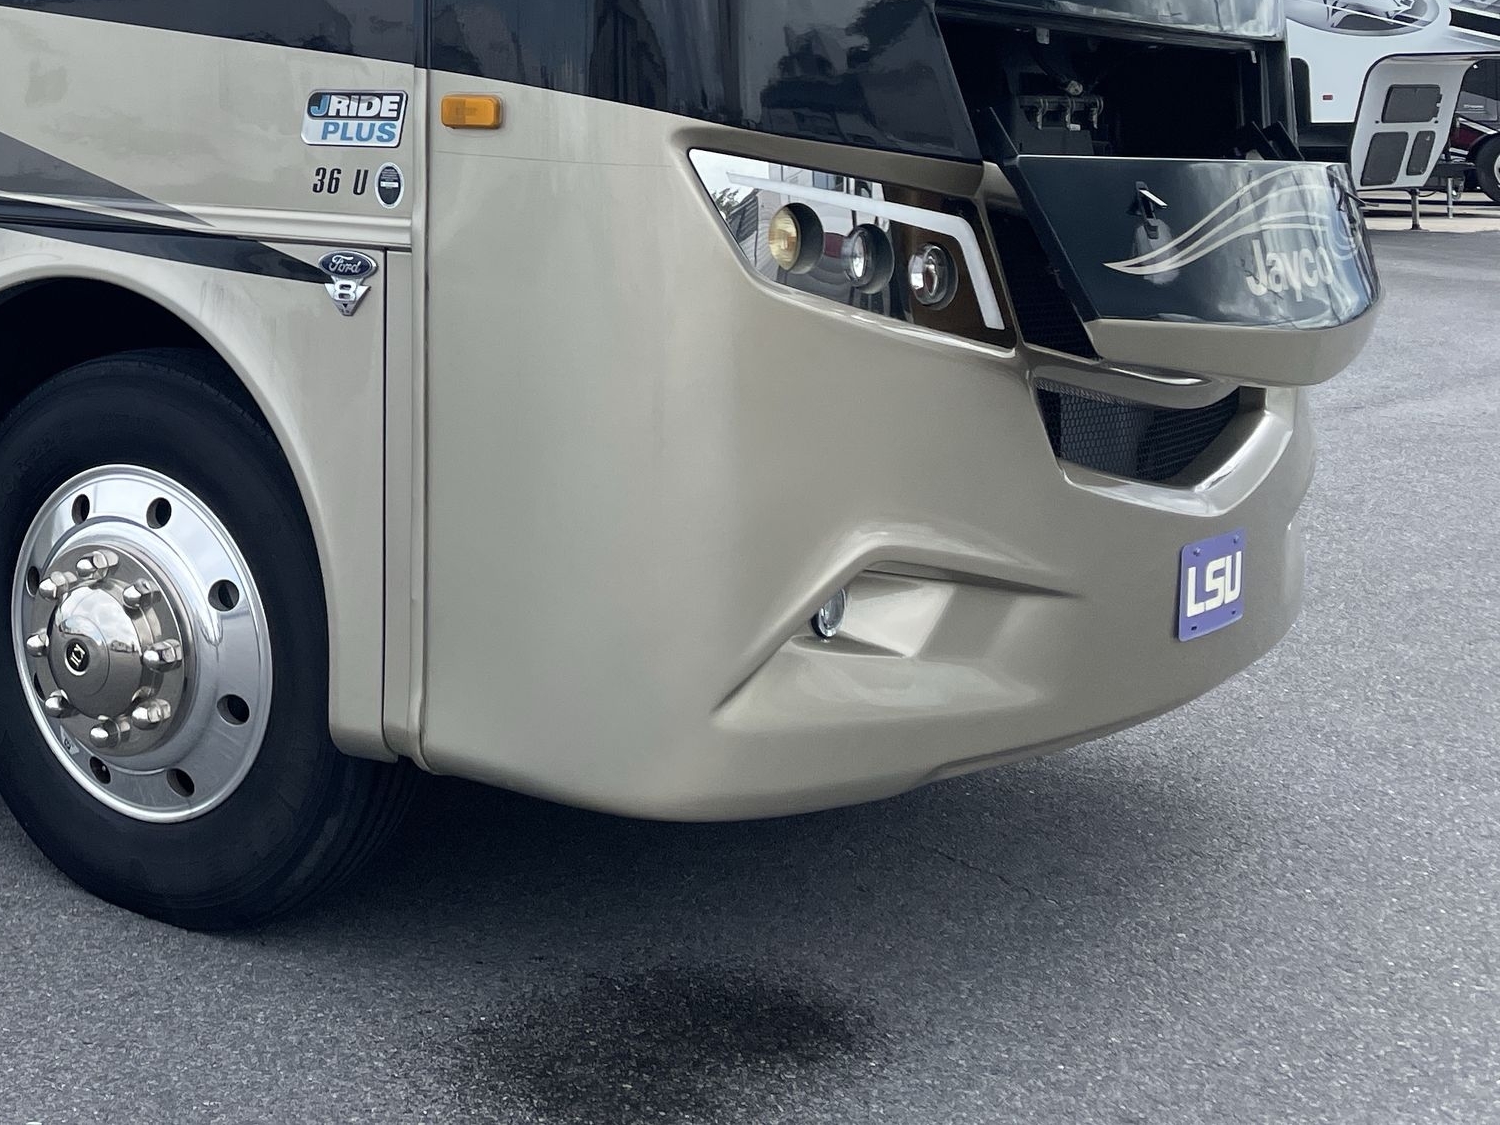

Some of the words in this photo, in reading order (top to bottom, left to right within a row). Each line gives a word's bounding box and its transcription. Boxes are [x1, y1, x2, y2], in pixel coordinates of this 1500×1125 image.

[321, 121, 397, 143] PLUS
[312, 166, 342, 194] 36
[352, 168, 369, 196] U
[329, 254, 362, 274] Ford
[1245, 238, 1335, 303] Jayco
[1187, 550, 1242, 618] LSU
